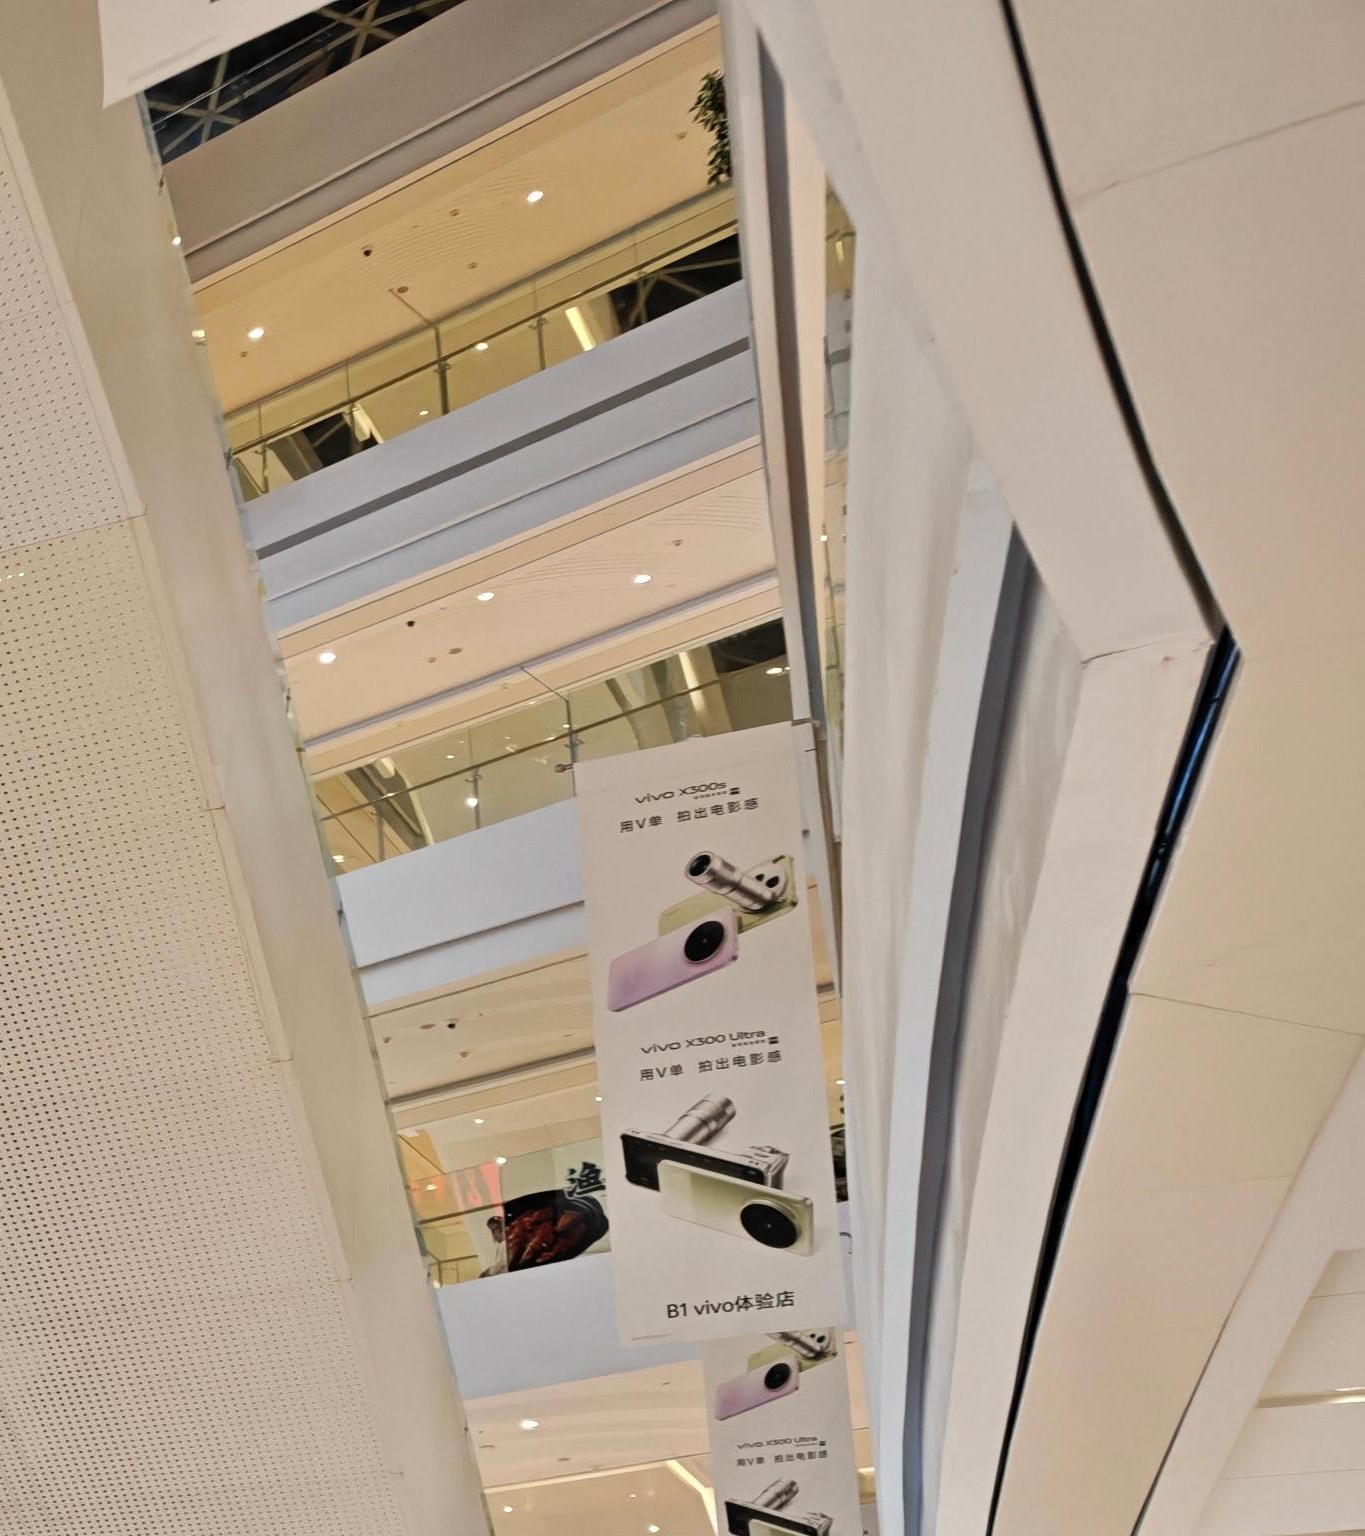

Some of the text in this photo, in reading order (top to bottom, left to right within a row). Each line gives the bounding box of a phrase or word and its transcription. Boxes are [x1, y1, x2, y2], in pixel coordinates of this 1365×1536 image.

[635, 791, 675, 804] vivo
[678, 782, 727, 796] X300s
[641, 1042, 681, 1054] vivo
[685, 1035, 726, 1048] X300
[729, 1031, 765, 1041] Ultra
[666, 1289, 795, 1319] B1 vivo体验店
